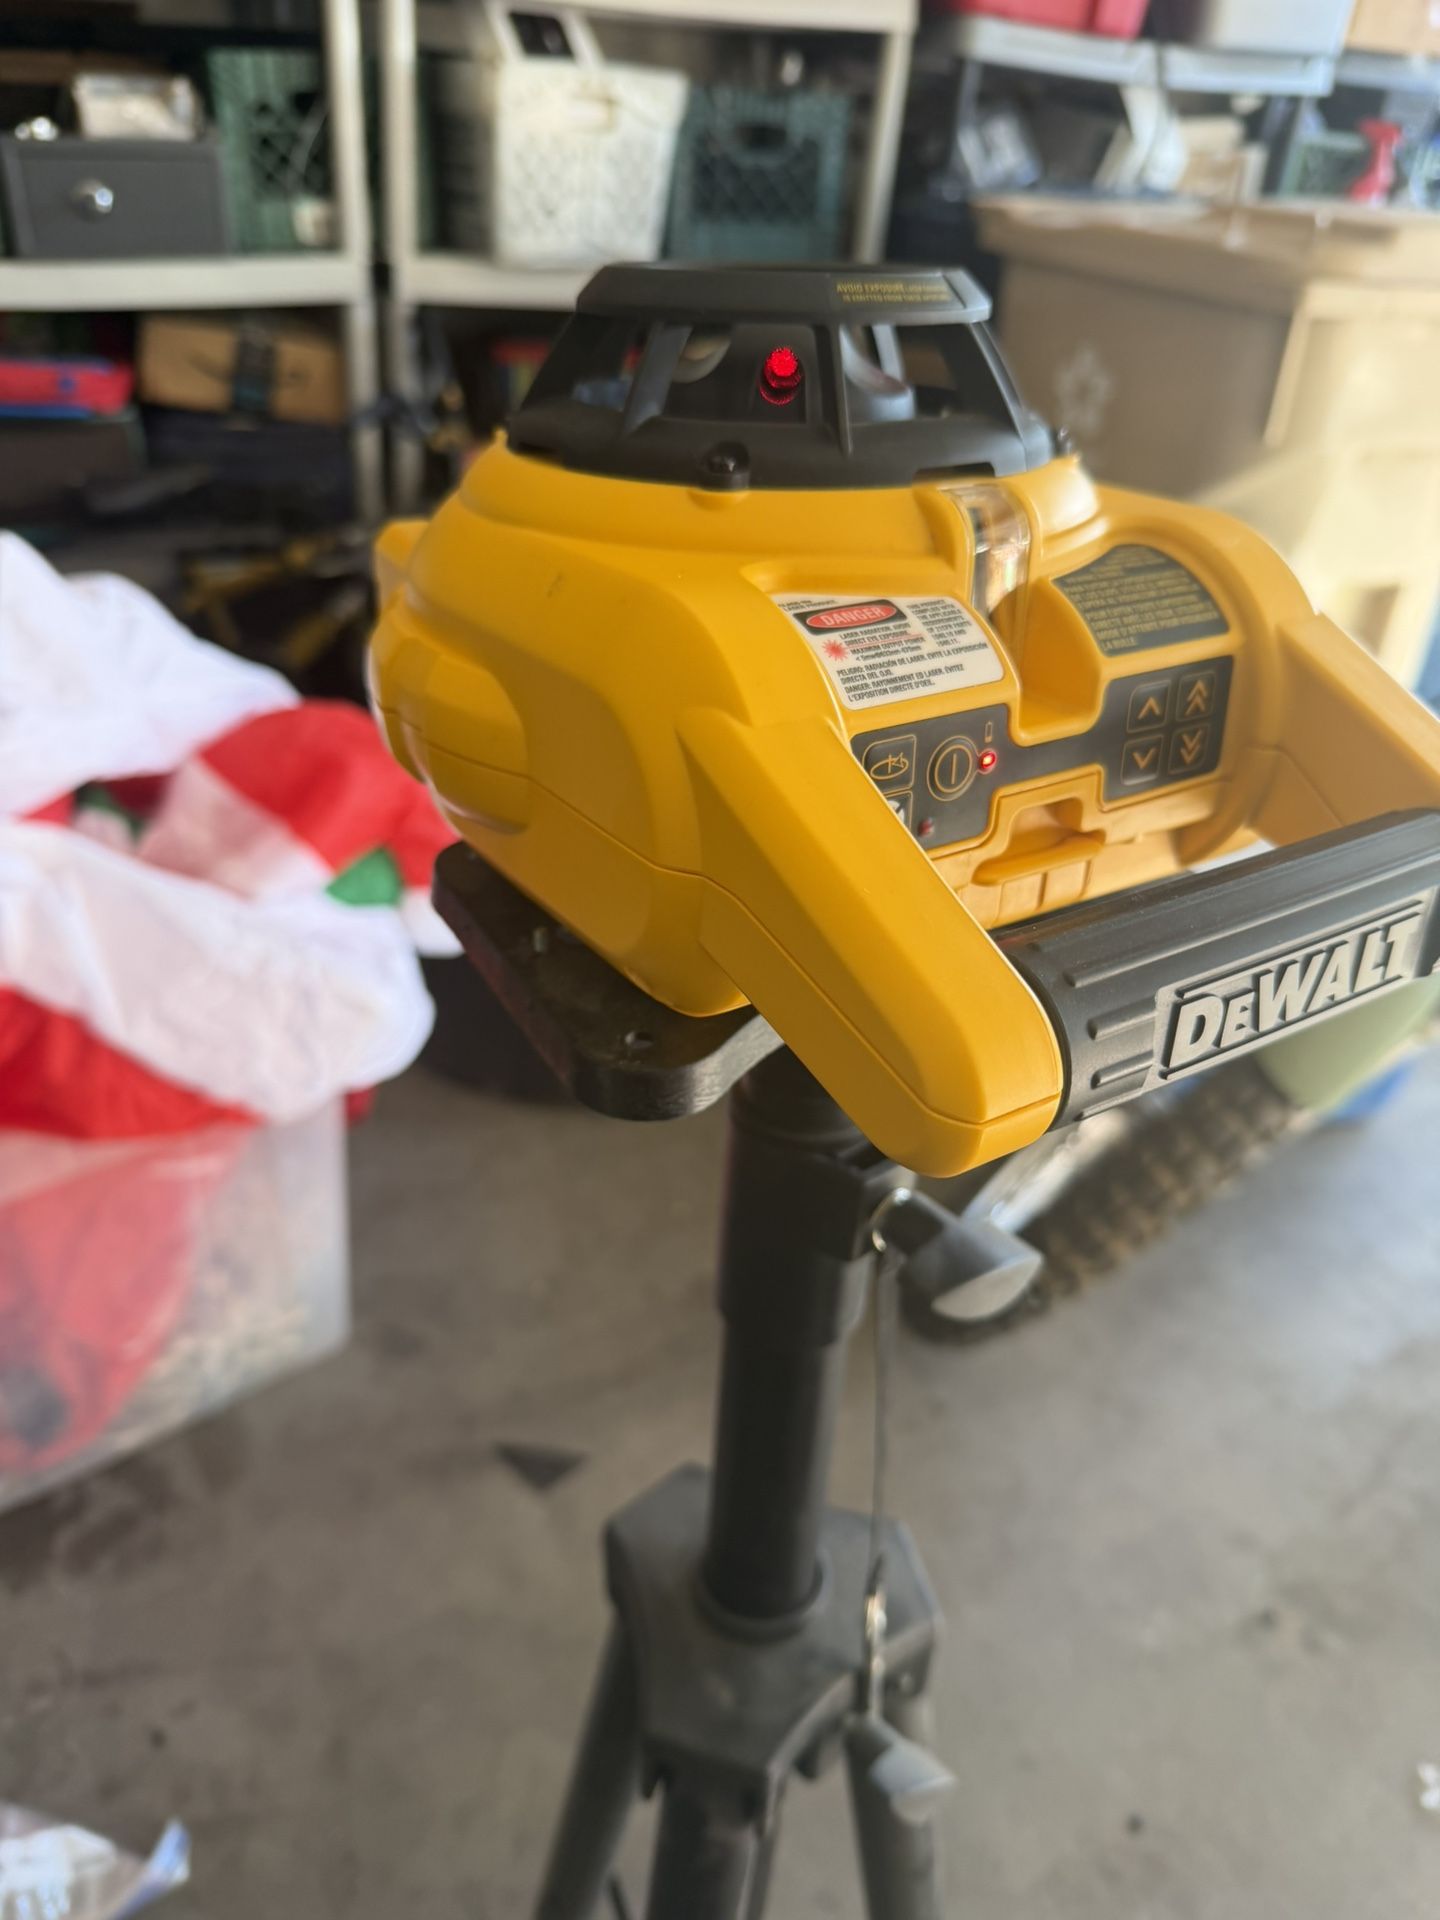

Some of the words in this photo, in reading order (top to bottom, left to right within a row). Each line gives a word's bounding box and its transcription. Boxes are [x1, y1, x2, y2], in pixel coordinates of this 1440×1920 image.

[819, 606, 885, 626] DANGER
[839, 629, 860, 640] LASER
[867, 635, 879, 643] EYE
[850, 644, 881, 655] MAXIMUM
[836, 666, 865, 677] PELIGRO:
[864, 659, 897, 671] RADIACIÓN
[943, 649, 952, 657] LA
[840, 674, 867, 685] DIRECTA
[867, 671, 879, 680] DEL
[844, 683, 872, 694] DANGER:
[872, 673, 915, 688] RAYONNEMENT
[847, 688, 889, 702] L'EXPOSITION
[889, 682, 914, 694] DIRECTE
